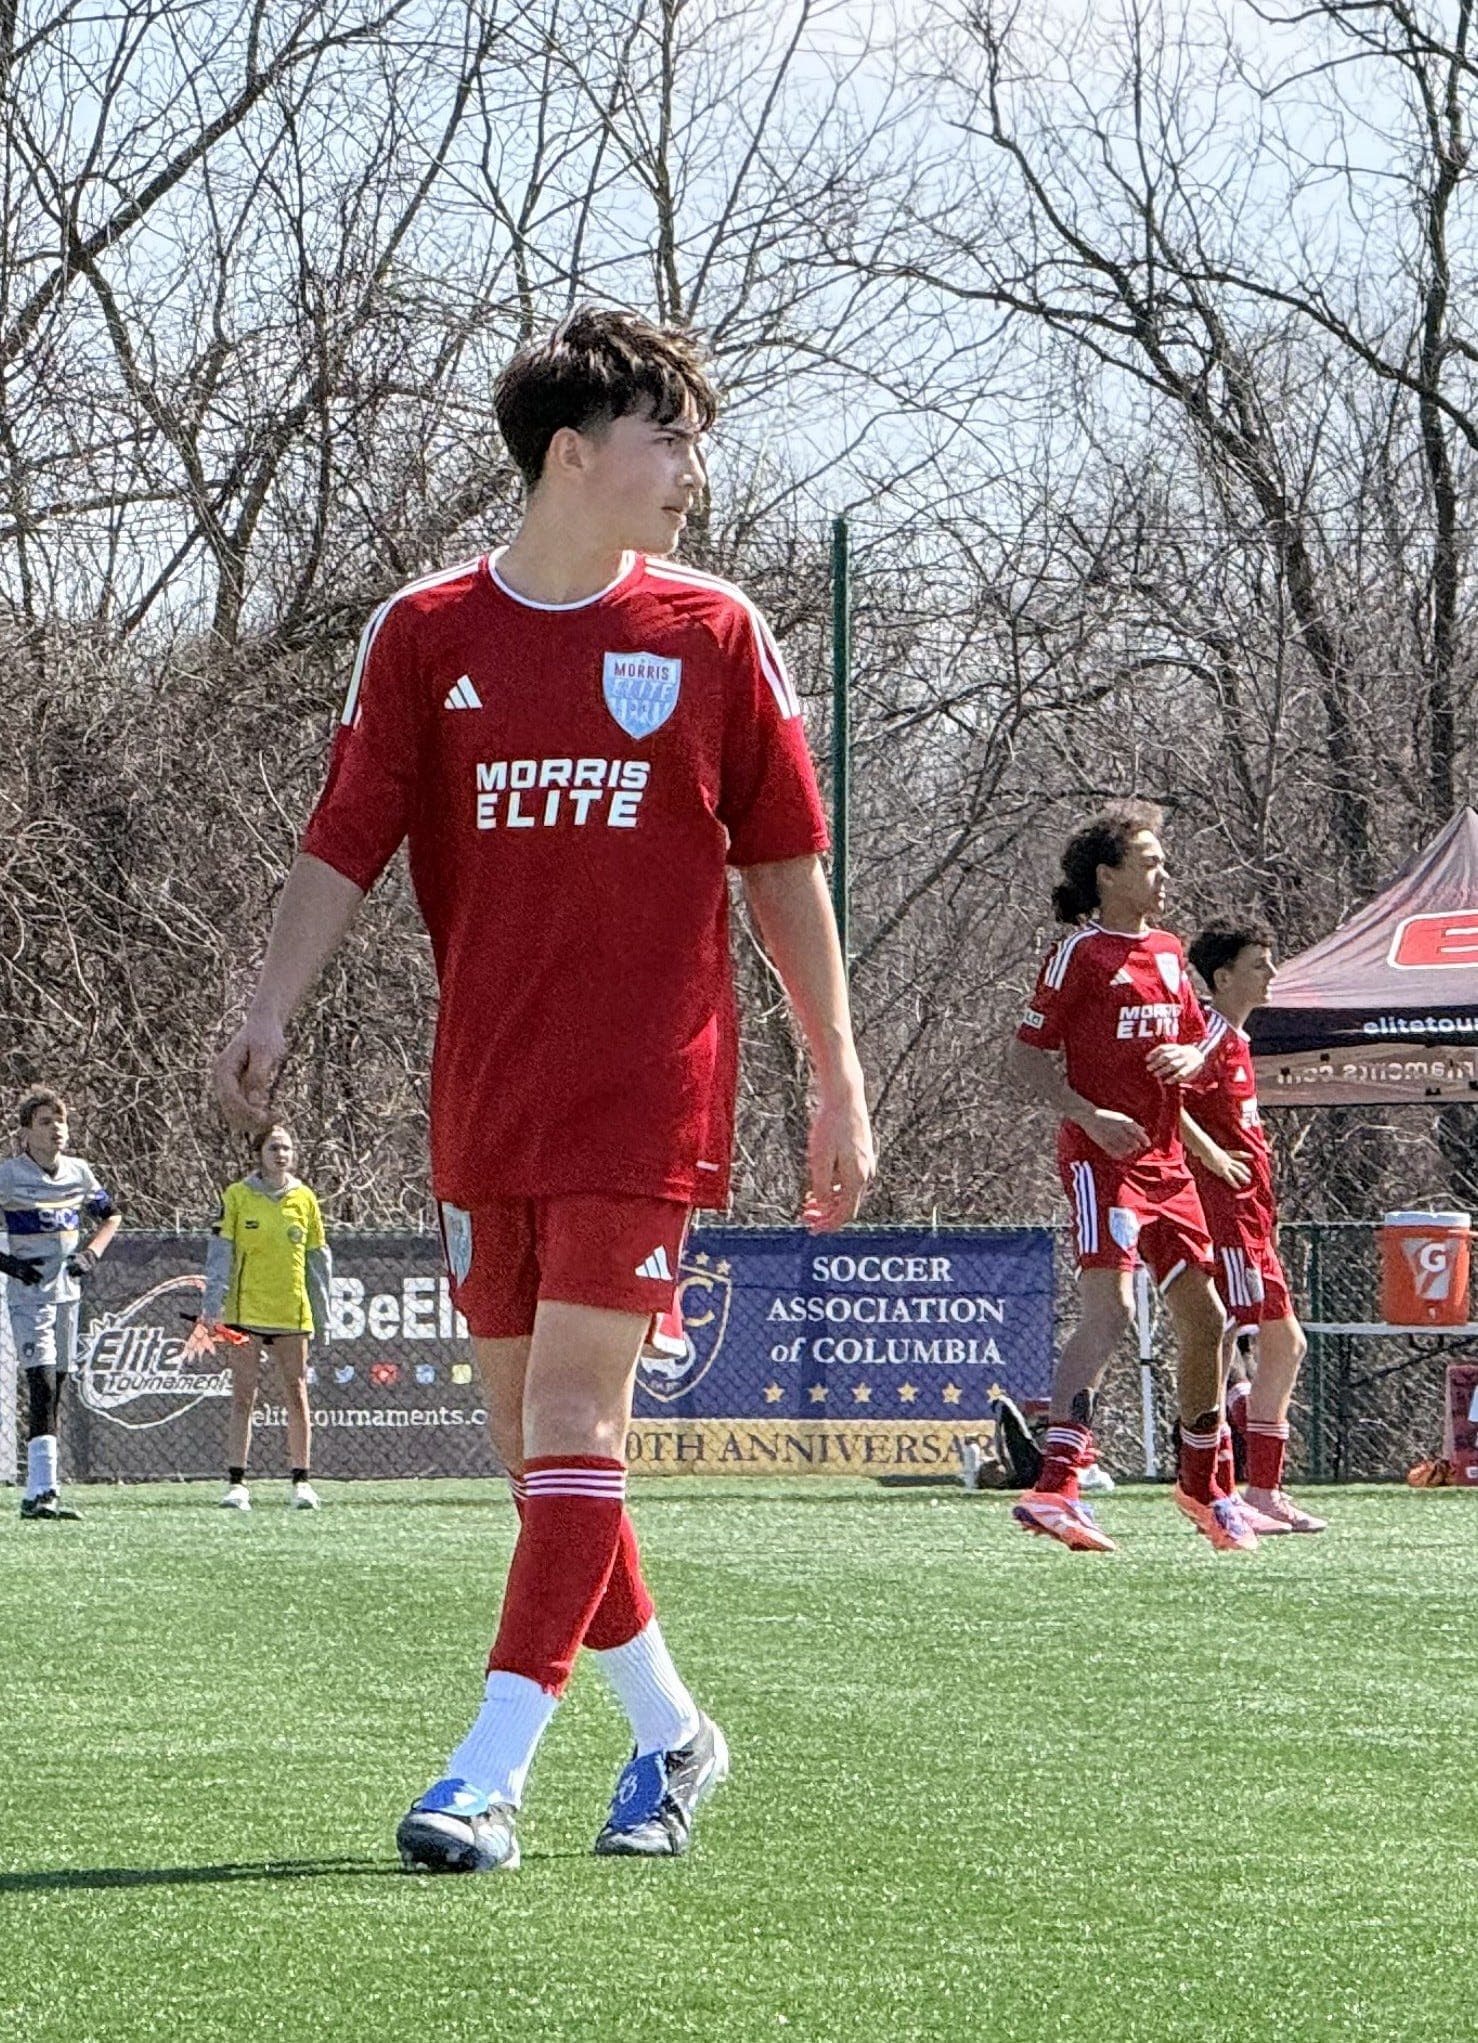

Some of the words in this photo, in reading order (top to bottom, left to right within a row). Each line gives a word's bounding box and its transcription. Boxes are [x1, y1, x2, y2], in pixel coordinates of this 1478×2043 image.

[613, 661, 670, 681] MORRIS
[476, 758, 651, 791] MORRIS
[476, 790, 643, 829] ELITE
[812, 1256, 954, 1283] SOCCER
[1420, 1243, 1446, 1272] G
[767, 1297, 1006, 1324] ASSOCIATION
[90, 1328, 187, 1372] Elite
[771, 1337, 807, 1364] of
[812, 1338, 1006, 1365] COLUMBIA
